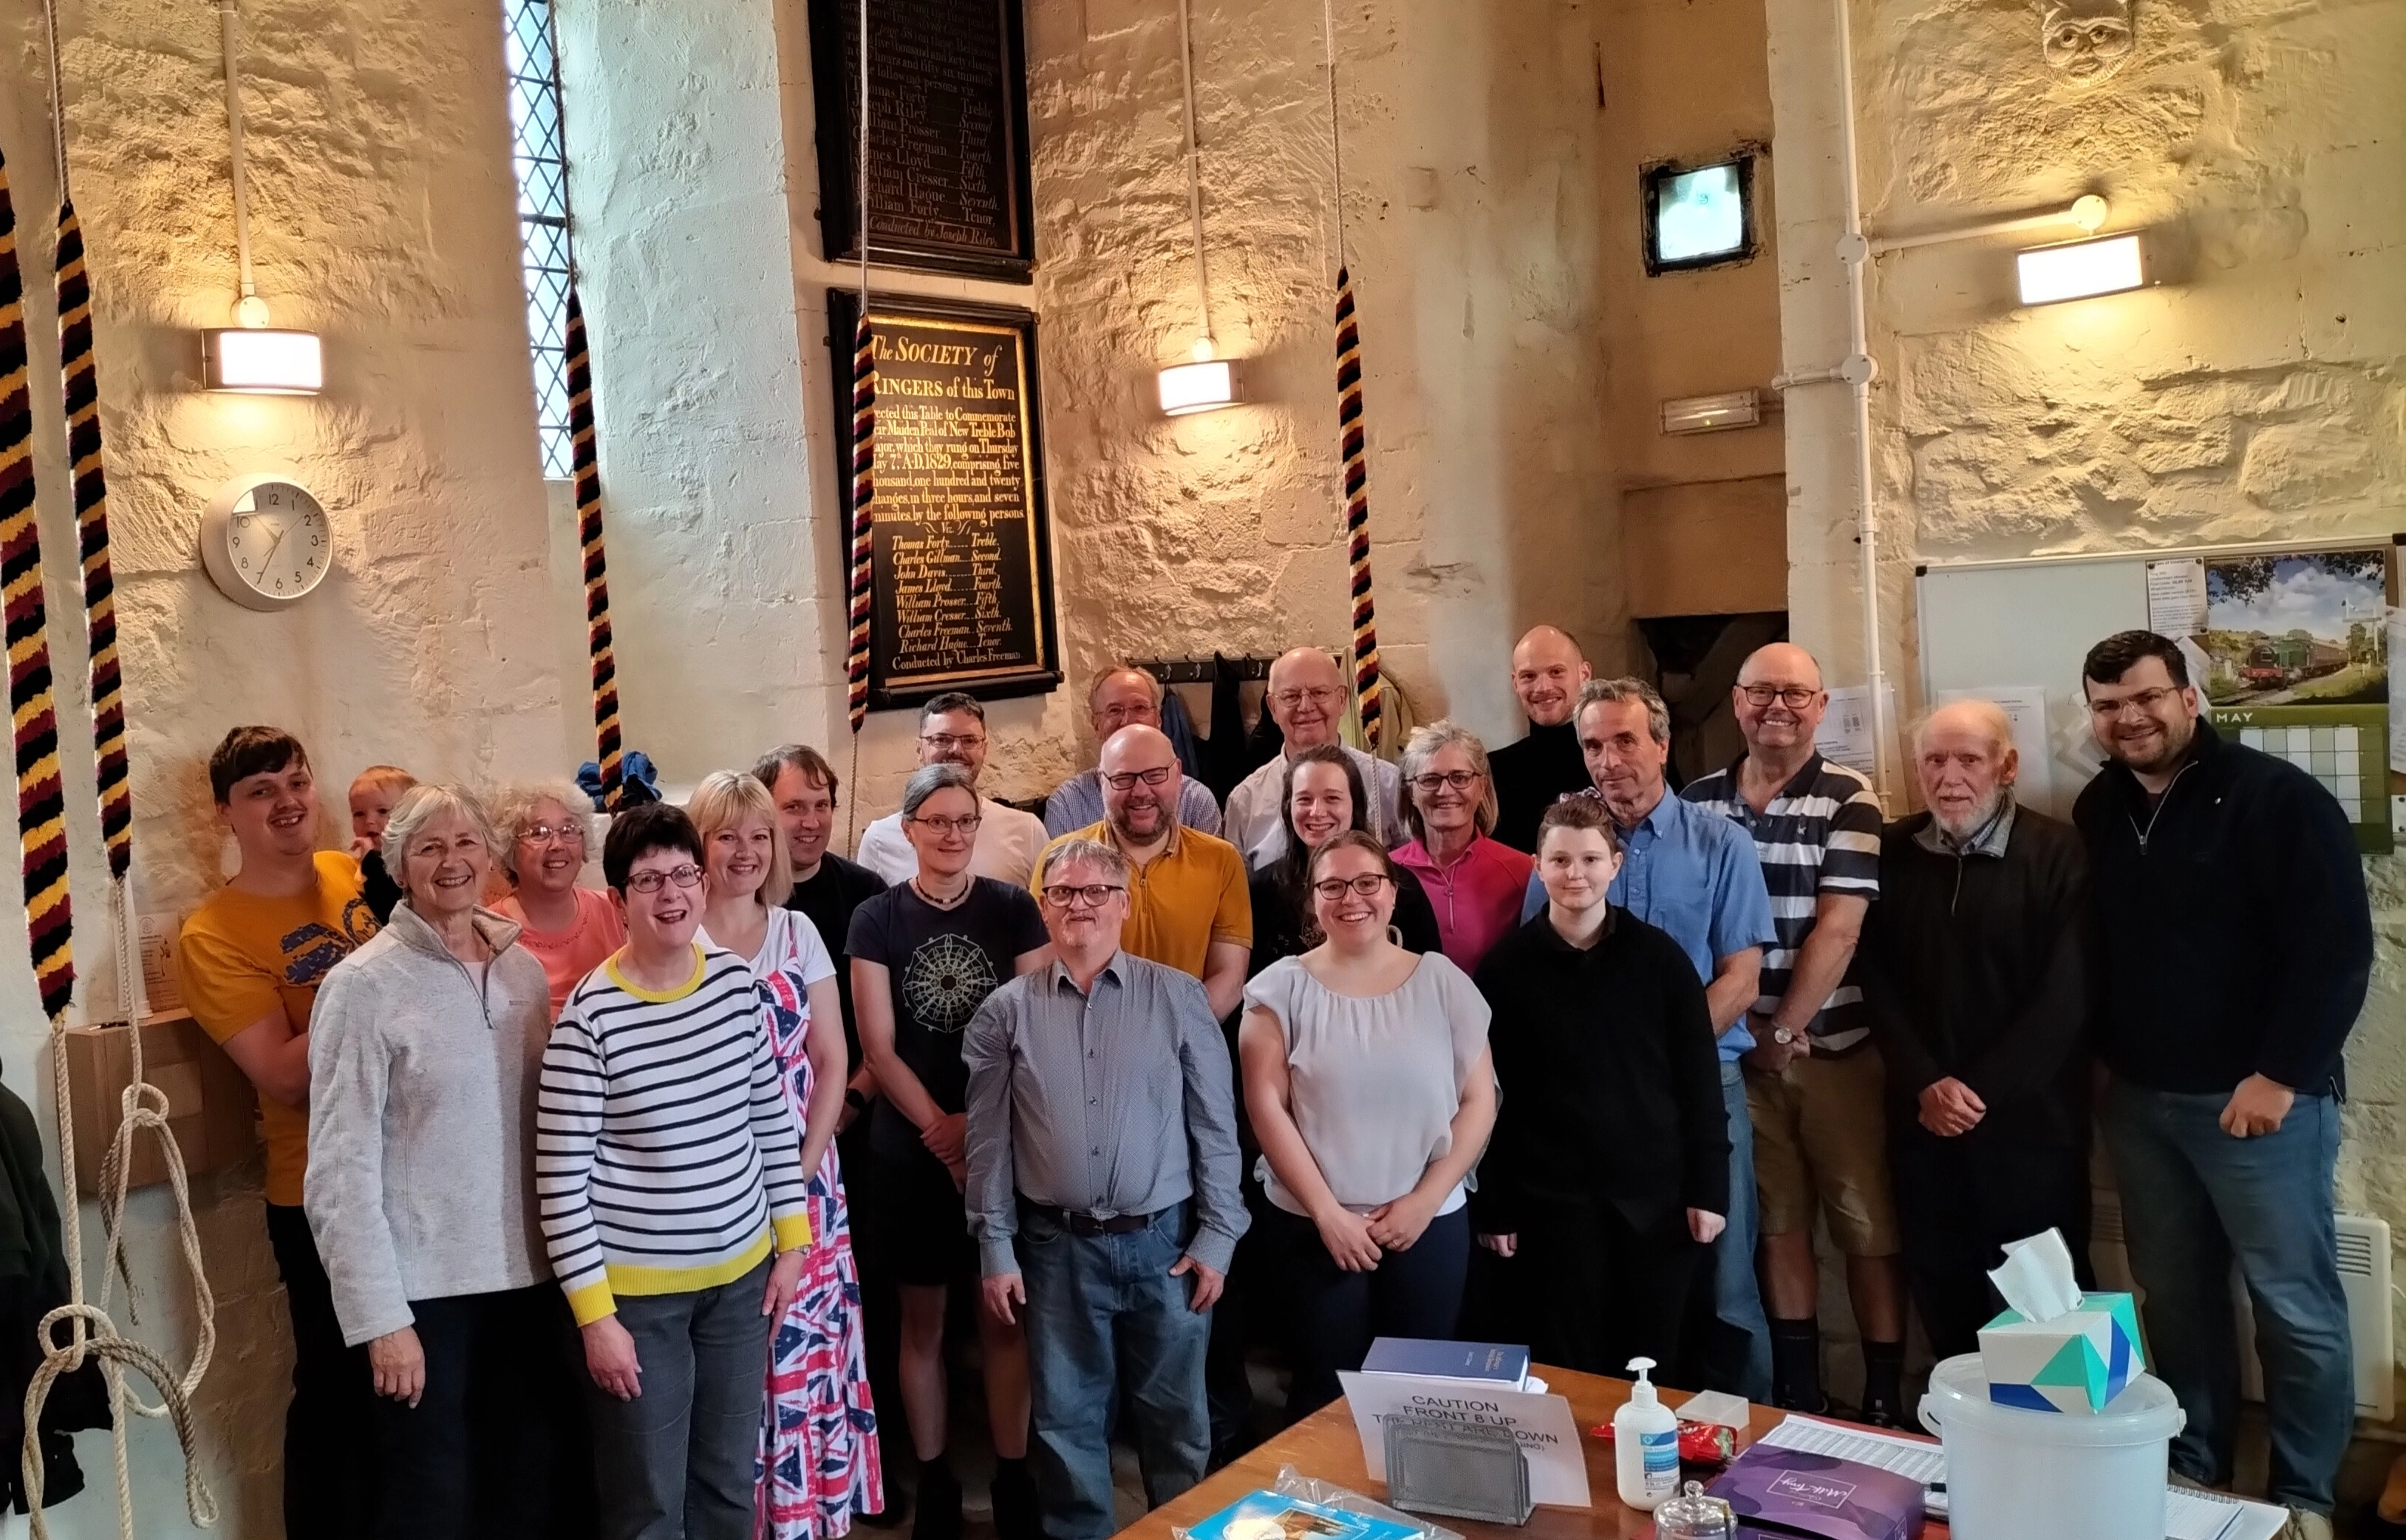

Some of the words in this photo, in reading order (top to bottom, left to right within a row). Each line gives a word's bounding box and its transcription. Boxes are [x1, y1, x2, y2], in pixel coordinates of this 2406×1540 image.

[875, 47, 901, 66] hours
[902, 56, 919, 70] and
[853, 75, 896, 98] Tomas
[853, 91, 892, 116] Jseph
[851, 107, 898, 132] Wlliam
[853, 125, 897, 146] Carles
[854, 141, 891, 160] Jmes
[869, 216, 920, 236] Conducted
[936, 225, 968, 244] Joseph
[872, 334, 893, 361] The
[895, 335, 978, 366] SOCIETY
[984, 344, 1003, 377] of
[947, 376, 960, 398] of
[962, 377, 984, 399] this
[984, 378, 1015, 401] Town
[902, 405, 919, 420] this
[919, 406, 944, 420] Table
[946, 408, 954, 420] to
[955, 407, 1016, 423] Commemorate
[887, 420, 919, 436] Maiden
[919, 420, 938, 437] Peal
[938, 420, 948, 437] of
[949, 420, 969, 437] New
[969, 422, 997, 437] Treble
[997, 423, 1016, 438] Bob
[874, 437, 895, 458] ajor,
[896, 437, 924, 453] which
[946, 441, 967, 460] rung
[969, 443, 979, 454] on
[979, 438, 1018, 458] Thursday
[1003, 454, 1020, 469] five
[873, 471, 915, 488] housand,
[915, 477, 931, 487] one
[933, 470, 969, 487] hundred
[971, 471, 987, 486] and
[990, 474, 1020, 491] twenty
[269, 493, 280, 505] 12
[910, 494, 920, 504] in
[921, 487, 945, 504] three
[975, 488, 992, 503] and
[994, 494, 1020, 503] seven
[291, 499, 295, 511] 1
[236, 516, 251, 528] 10
[304, 514, 312, 526] 2
[913, 505, 924, 526] by
[926, 505, 942, 520] the
[944, 504, 986, 528] following
[232, 536, 240, 548] 9
[310, 534, 318, 547] 3
[892, 535, 924, 551] Thomas
[925, 534, 950, 551] Forty
[241, 556, 249, 569] 8
[307, 556, 315, 568] 4
[893, 550, 924, 565] Charles
[926, 549, 961, 564] Gillman
[256, 571, 263, 585] 7
[294, 571, 302, 583] 5
[894, 565, 916, 579] John
[275, 577, 284, 590] 6
[896, 580, 923, 595] James
[896, 593, 932, 609] William
[932, 594, 966, 608] Prosser
[897, 609, 933, 624] William
[934, 609, 966, 622] Cresser
[899, 624, 932, 638] Charles
[933, 622, 969, 636] Freeman
[899, 638, 938, 654] Richard
[892, 653, 941, 670] Conducted
[943, 652, 954, 670] by
[2216, 712, 2254, 723] MAY
[1412, 1395, 1499, 1413] CAUTION
[1403, 1406, 1468, 1423] FRONT
[1474, 1414, 1485, 1424] 8
[1490, 1416, 1517, 1426] UP
[1779, 1477, 1811, 1492] Tray
[1809, 1485, 1847, 1497] Milk
